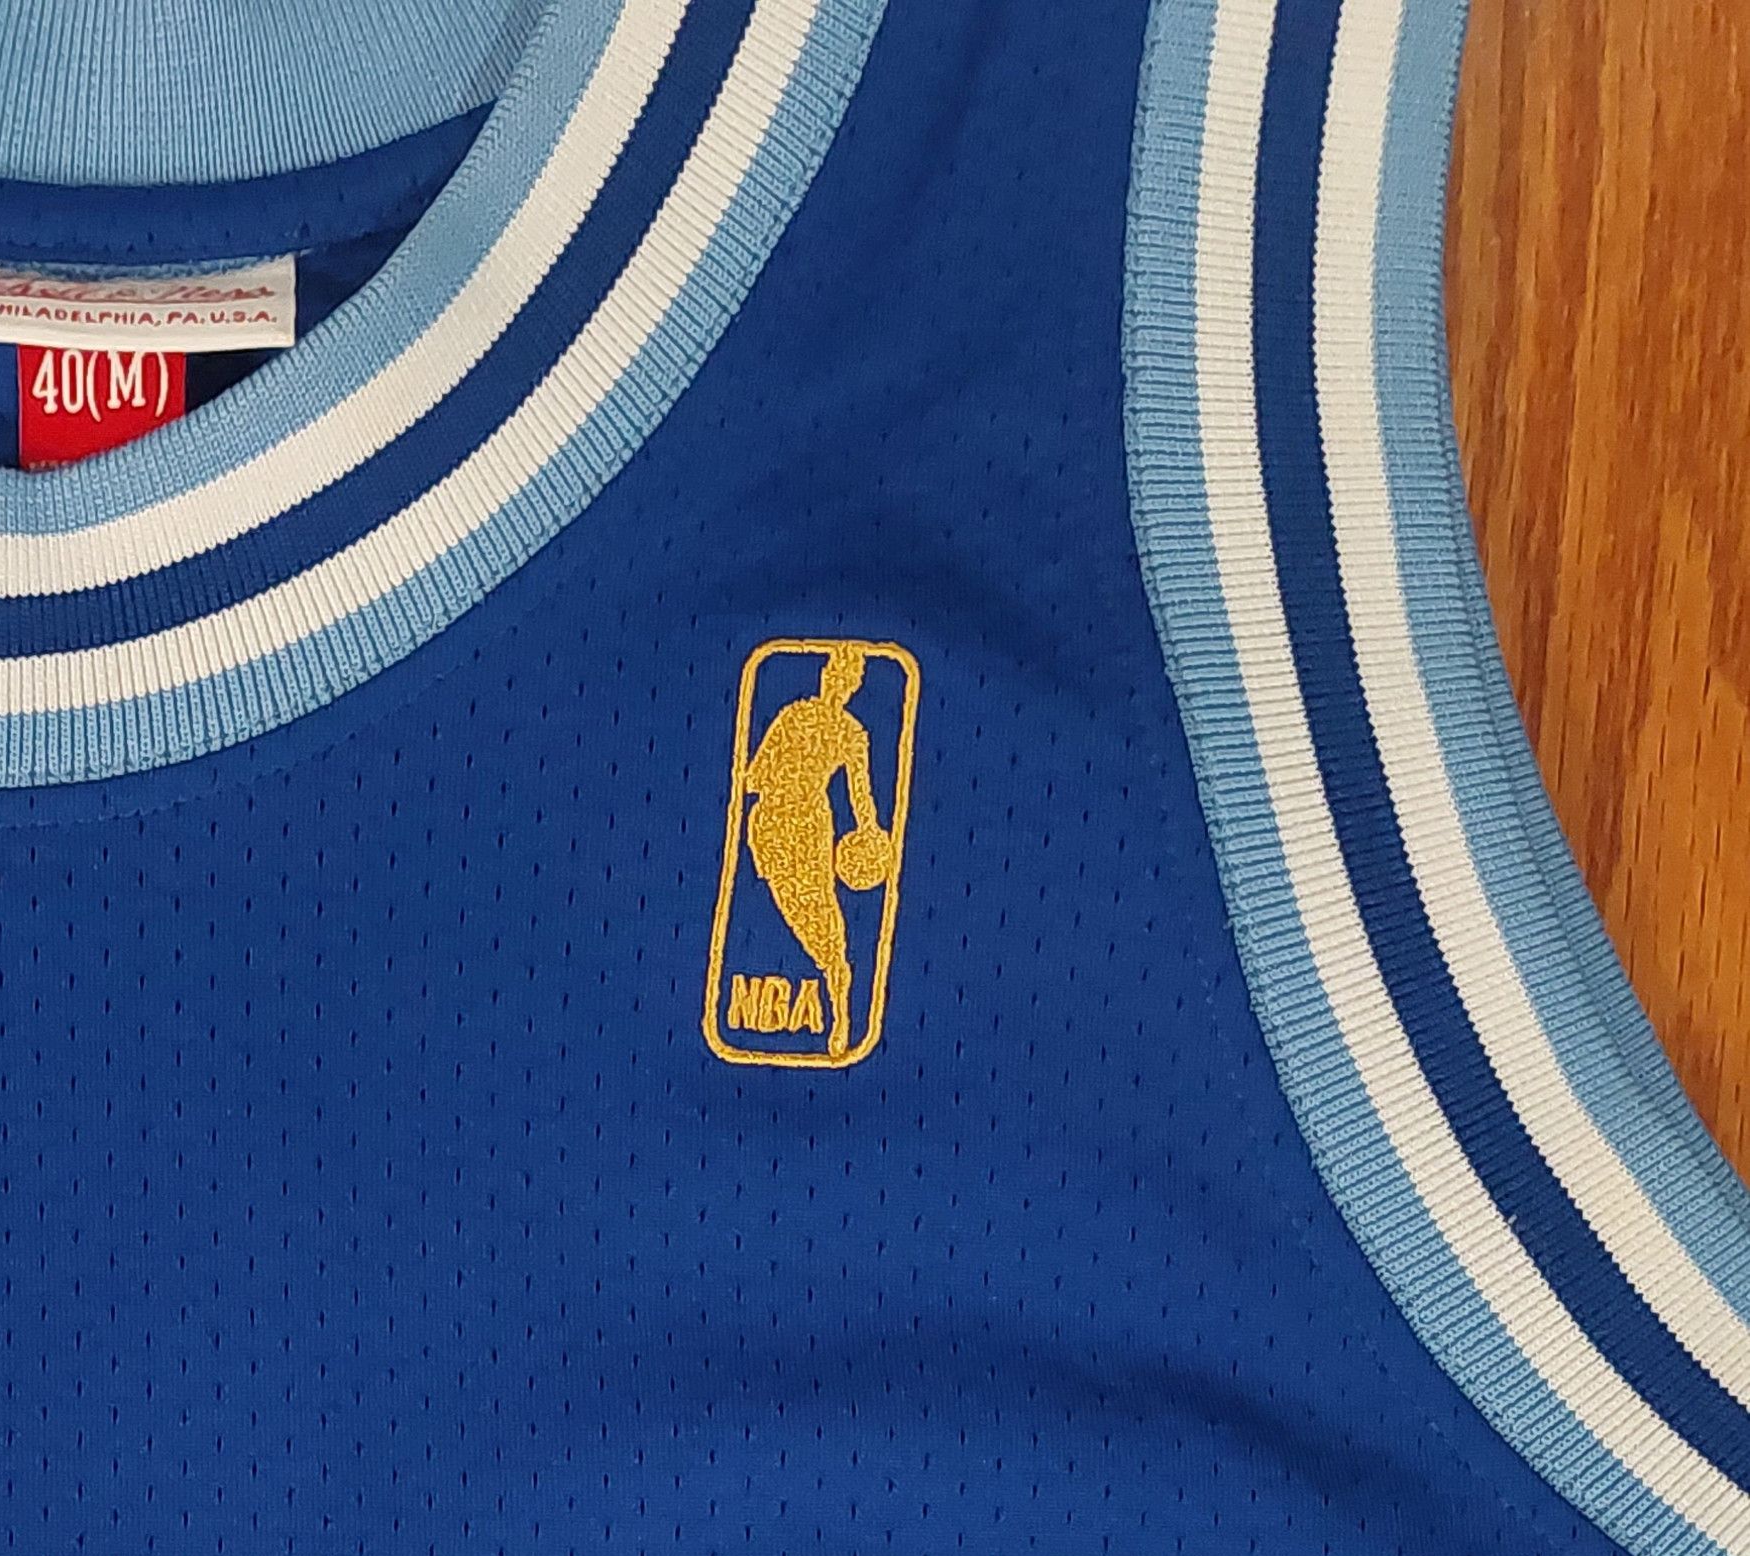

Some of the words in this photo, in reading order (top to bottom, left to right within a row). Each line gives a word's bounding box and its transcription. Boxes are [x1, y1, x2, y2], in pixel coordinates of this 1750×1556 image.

[209, 310, 278, 325] U.S.A.
[31, 349, 169, 422] 40(M)
[728, 974, 823, 1034] NBA
